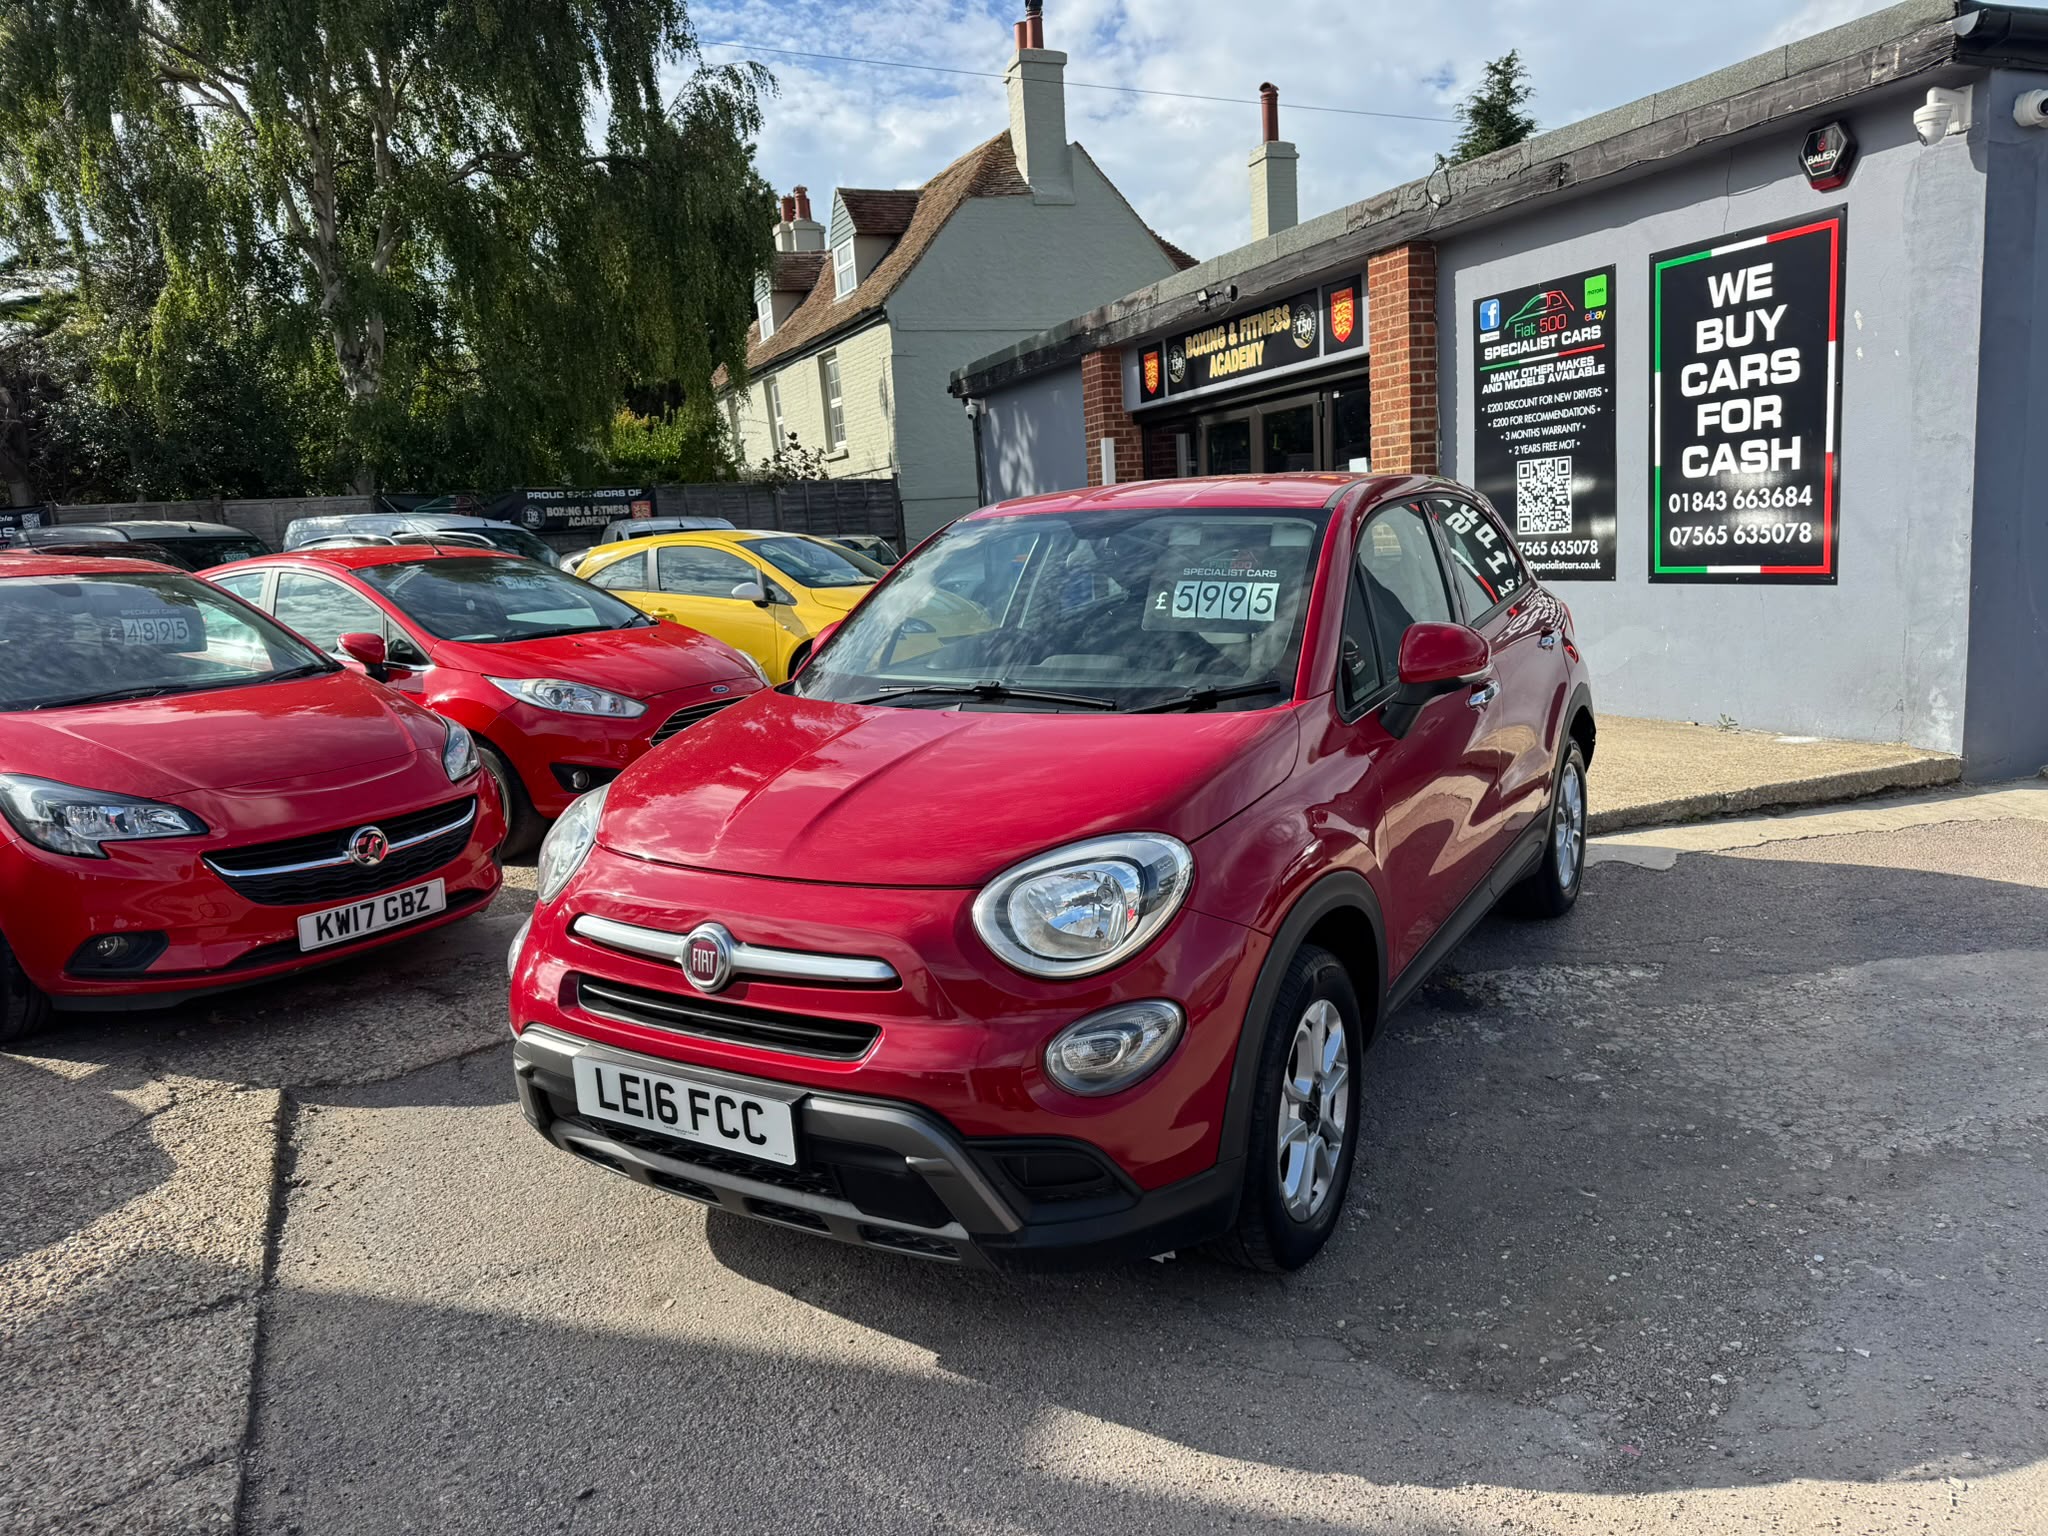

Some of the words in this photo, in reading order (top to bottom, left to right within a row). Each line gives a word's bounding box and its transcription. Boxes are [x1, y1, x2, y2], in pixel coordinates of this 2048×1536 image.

[1808, 150, 1836, 165] BAUER
[1707, 262, 1773, 309] WE
[1515, 321, 1536, 339] Fiat
[1540, 314, 1567, 333] 500
[1585, 310, 1606, 322] ebay
[1696, 304, 1788, 354] BUY
[1185, 325, 1226, 359] BOXING
[1228, 322, 1238, 346] &
[1240, 304, 1291, 343] FITNESS
[1484, 333, 1558, 361] SPECIALIST
[1561, 325, 1602, 345] CARS
[1209, 340, 1265, 379] ACADEMY
[1490, 369, 1519, 384] MANY
[1521, 363, 1554, 378] OTHER
[1557, 355, 1595, 371] MAKES
[1681, 347, 1801, 398] CARS
[1482, 383, 1503, 394] AND
[1505, 375, 1545, 391] MODELS
[1547, 364, 1605, 384] AVAILABLE
[1487, 402, 1503, 413] £200
[1504, 396, 1538, 411] DISCOUNT
[1539, 394, 1553, 405] FOR
[1554, 391, 1572, 403] NEW
[1573, 387, 1602, 400] DRIVERS
[1493, 418, 1509, 428] £200
[1510, 415, 1523, 426] FOR
[1524, 405, 1596, 424] RECOMMENDATIONS
[1697, 395, 1783, 436] FOR
[1505, 431, 1510, 441] 3
[1511, 427, 1541, 440] MONTHS
[1541, 422, 1581, 436] WARRANTY
[1514, 446, 1520, 455] 2
[1520, 444, 1541, 454] YEARS
[1542, 442, 1558, 452] FREE
[1559, 439, 1575, 450] MOT
[1682, 436, 1801, 479] CASH
[527, 491, 565, 500] PROUD
[628, 489, 642, 498] OF
[1668, 490, 1727, 513] 01843
[1732, 485, 1813, 510] 663684
[568, 516, 611, 527] ACADEMY
[583, 505, 591, 516] &
[1669, 525, 1728, 546] 07565
[1733, 522, 1812, 544] 635078
[1550, 540, 1598, 556] 635078
[1183, 568, 1244, 577] SPECIALIST
[1246, 569, 1277, 578] CARS
[315, 902, 375, 941] KW17
[384, 886, 431, 922] GBZ
[693, 947, 716, 974] FIAT
[595, 1068, 678, 1125] LE16
[688, 1088, 767, 1146] FCC
